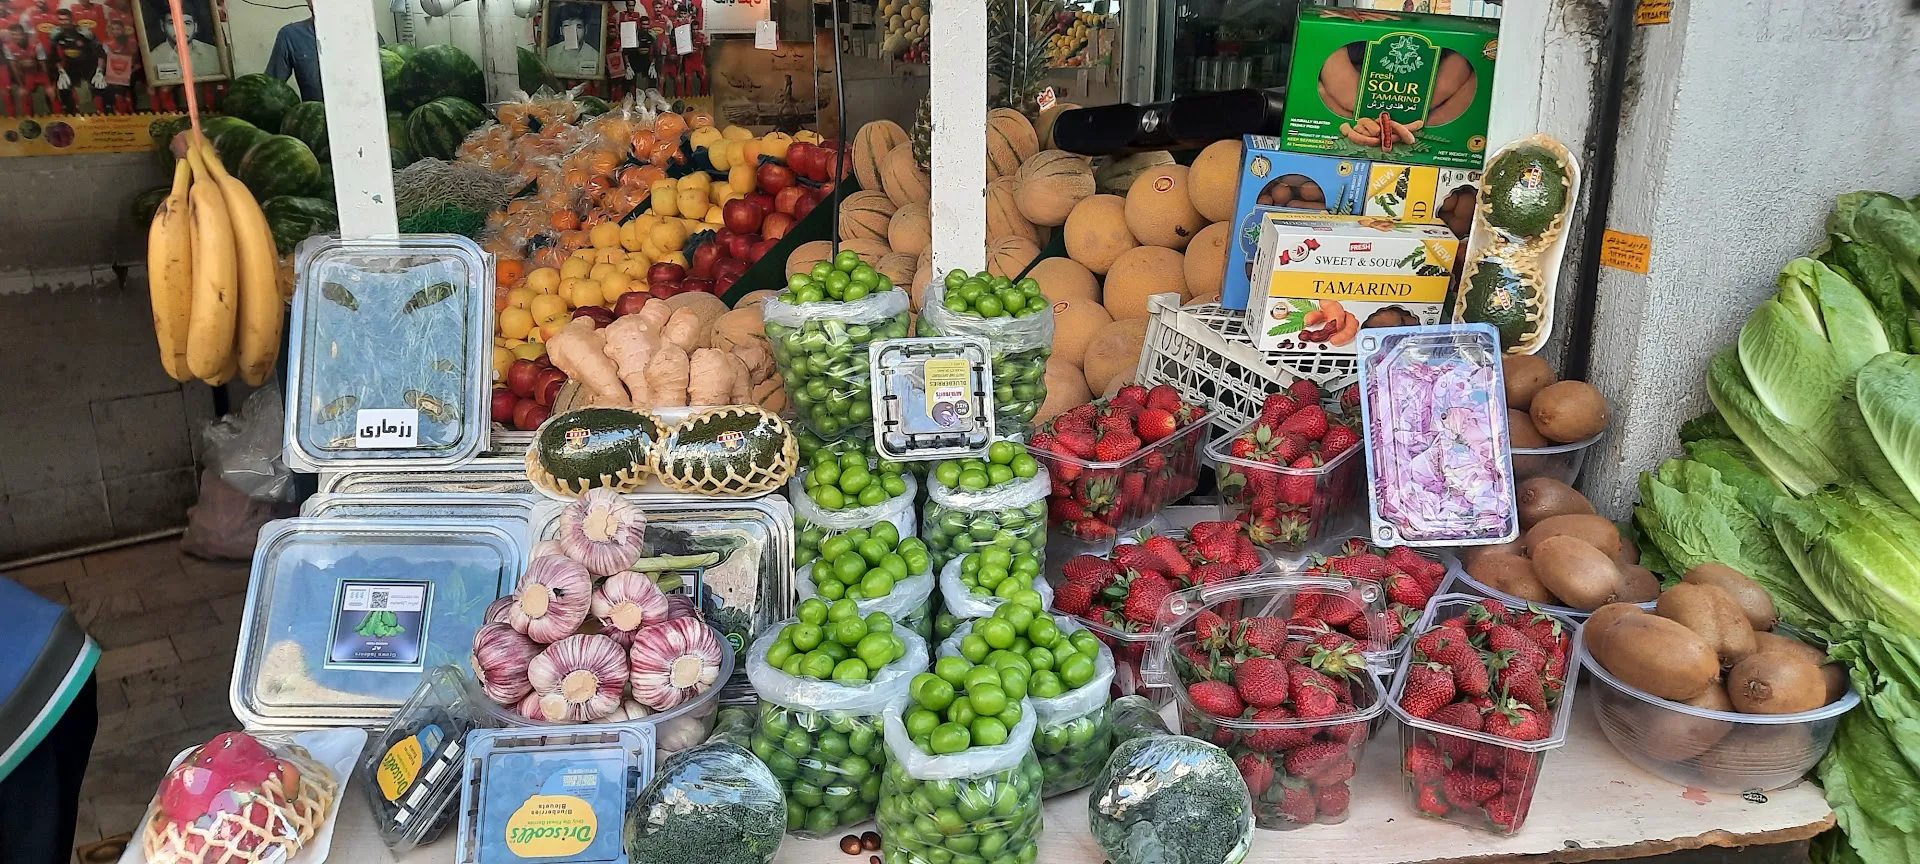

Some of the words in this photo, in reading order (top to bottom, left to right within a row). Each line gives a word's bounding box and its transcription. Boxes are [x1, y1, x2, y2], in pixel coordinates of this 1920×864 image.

[1379, 56, 1424, 74] NATCHA
[1370, 71, 1394, 80] Fresh
[1368, 79, 1419, 95] SOUR
[1371, 92, 1421, 104] TAMARIND
[1372, 169, 1395, 190] NEW
[1350, 243, 1371, 251] FRESH
[1432, 242, 1453, 263] NEW
[1315, 255, 1355, 266] SWEET
[1357, 258, 1367, 267] &
[1370, 258, 1401, 269] SOUR
[1313, 280, 1412, 296] TAMARIND
[360, 418, 412, 438] رزماری
[511, 825, 592, 844] Driscoll's
